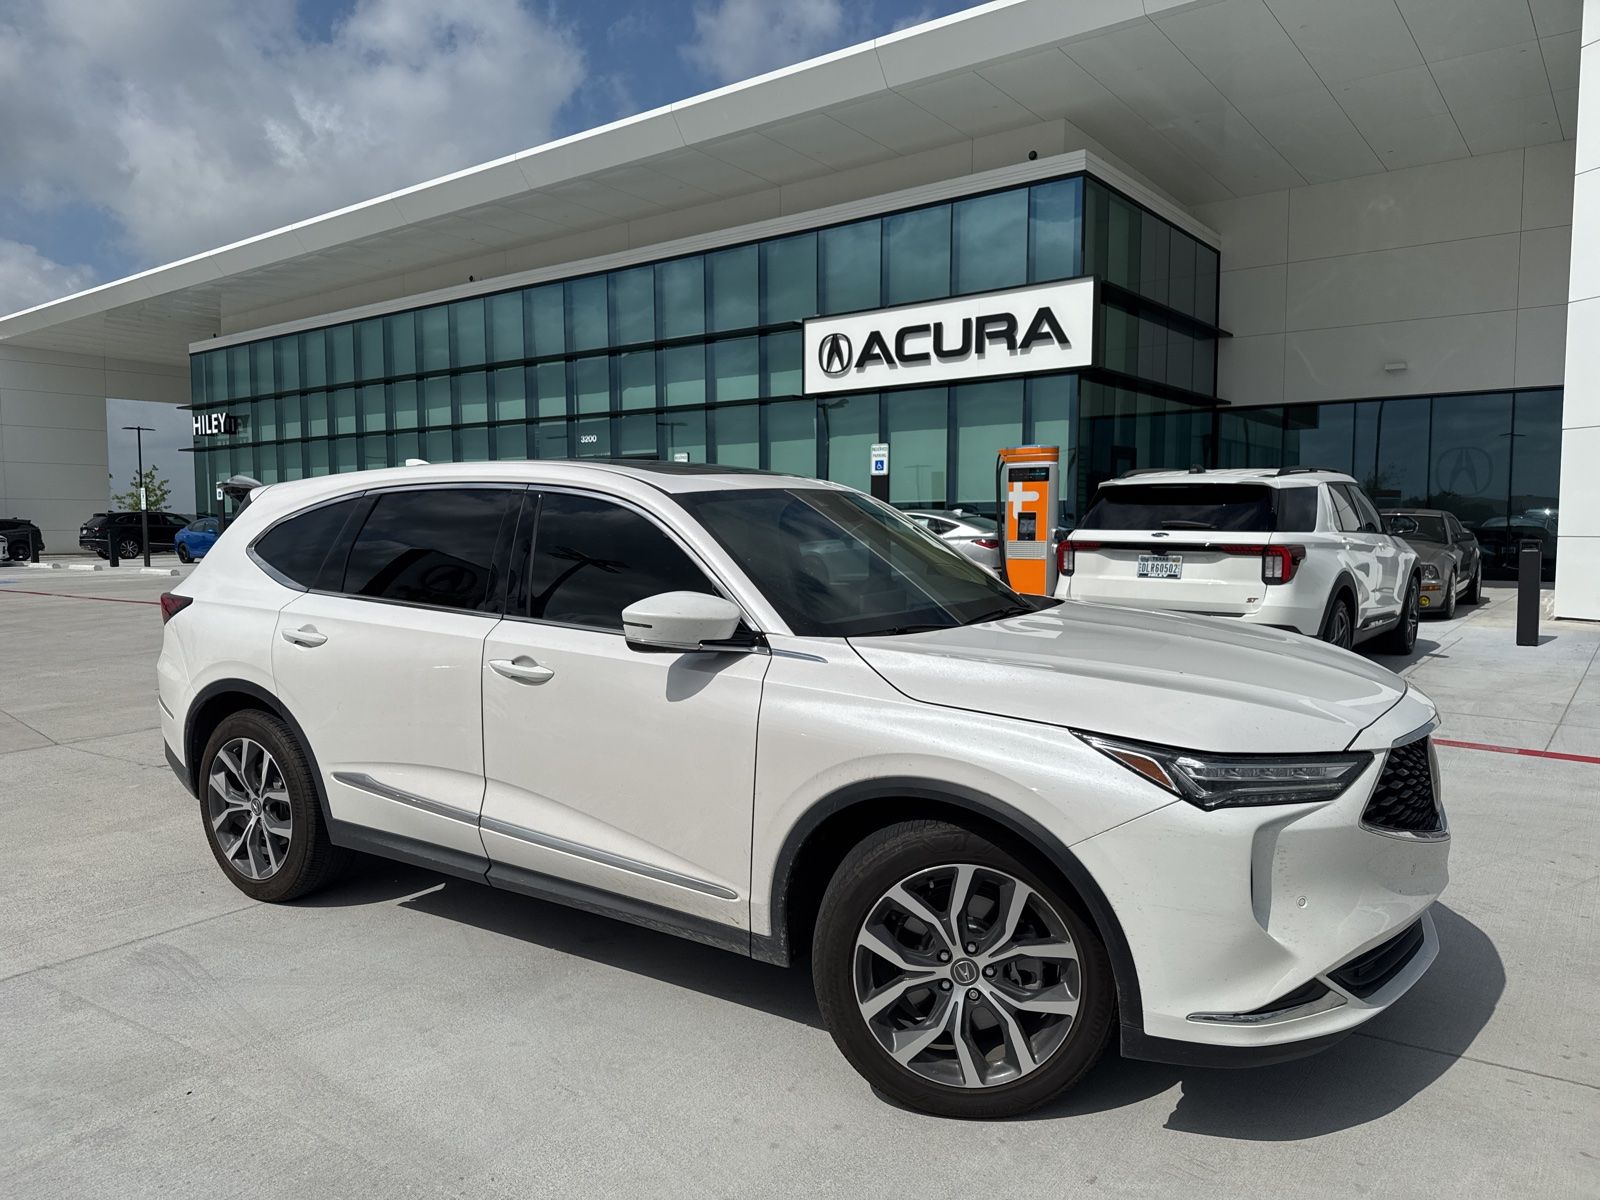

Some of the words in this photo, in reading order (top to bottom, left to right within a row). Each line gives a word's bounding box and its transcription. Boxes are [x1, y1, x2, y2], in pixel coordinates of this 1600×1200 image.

[854, 306, 1070, 369] ACURA
[192, 412, 226, 436] HILEY
[580, 435, 597, 443] 3200
